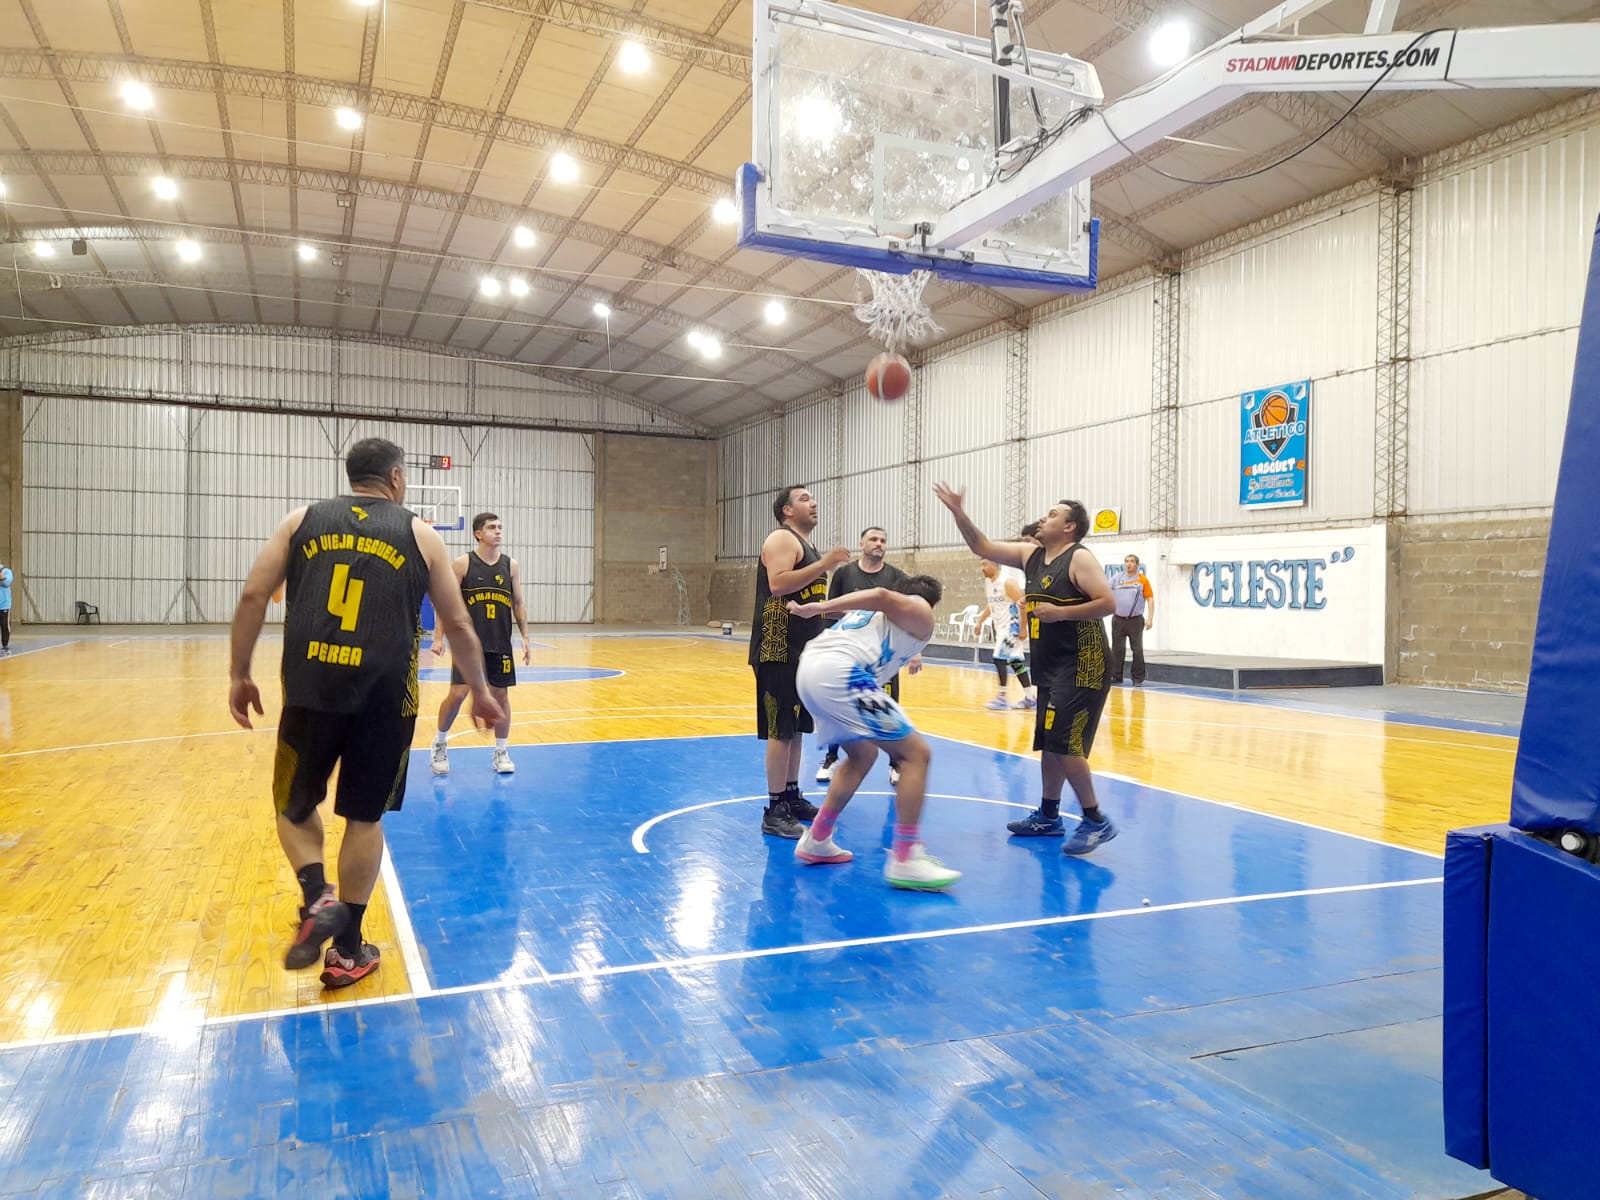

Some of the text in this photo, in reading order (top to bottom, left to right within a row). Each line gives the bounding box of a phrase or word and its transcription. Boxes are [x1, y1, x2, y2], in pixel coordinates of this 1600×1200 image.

[1226, 47, 1440, 72] STADIUMDEPORTES.COM
[1244, 421, 1306, 443] ATLETICO
[442, 457, 449, 468] 9
[302, 533, 406, 571] LA VIEJA ESCUELA
[327, 563, 365, 632] 4
[485, 603, 496, 619] 13
[306, 640, 364, 667] PEREA
[501, 659, 511, 673] 13
